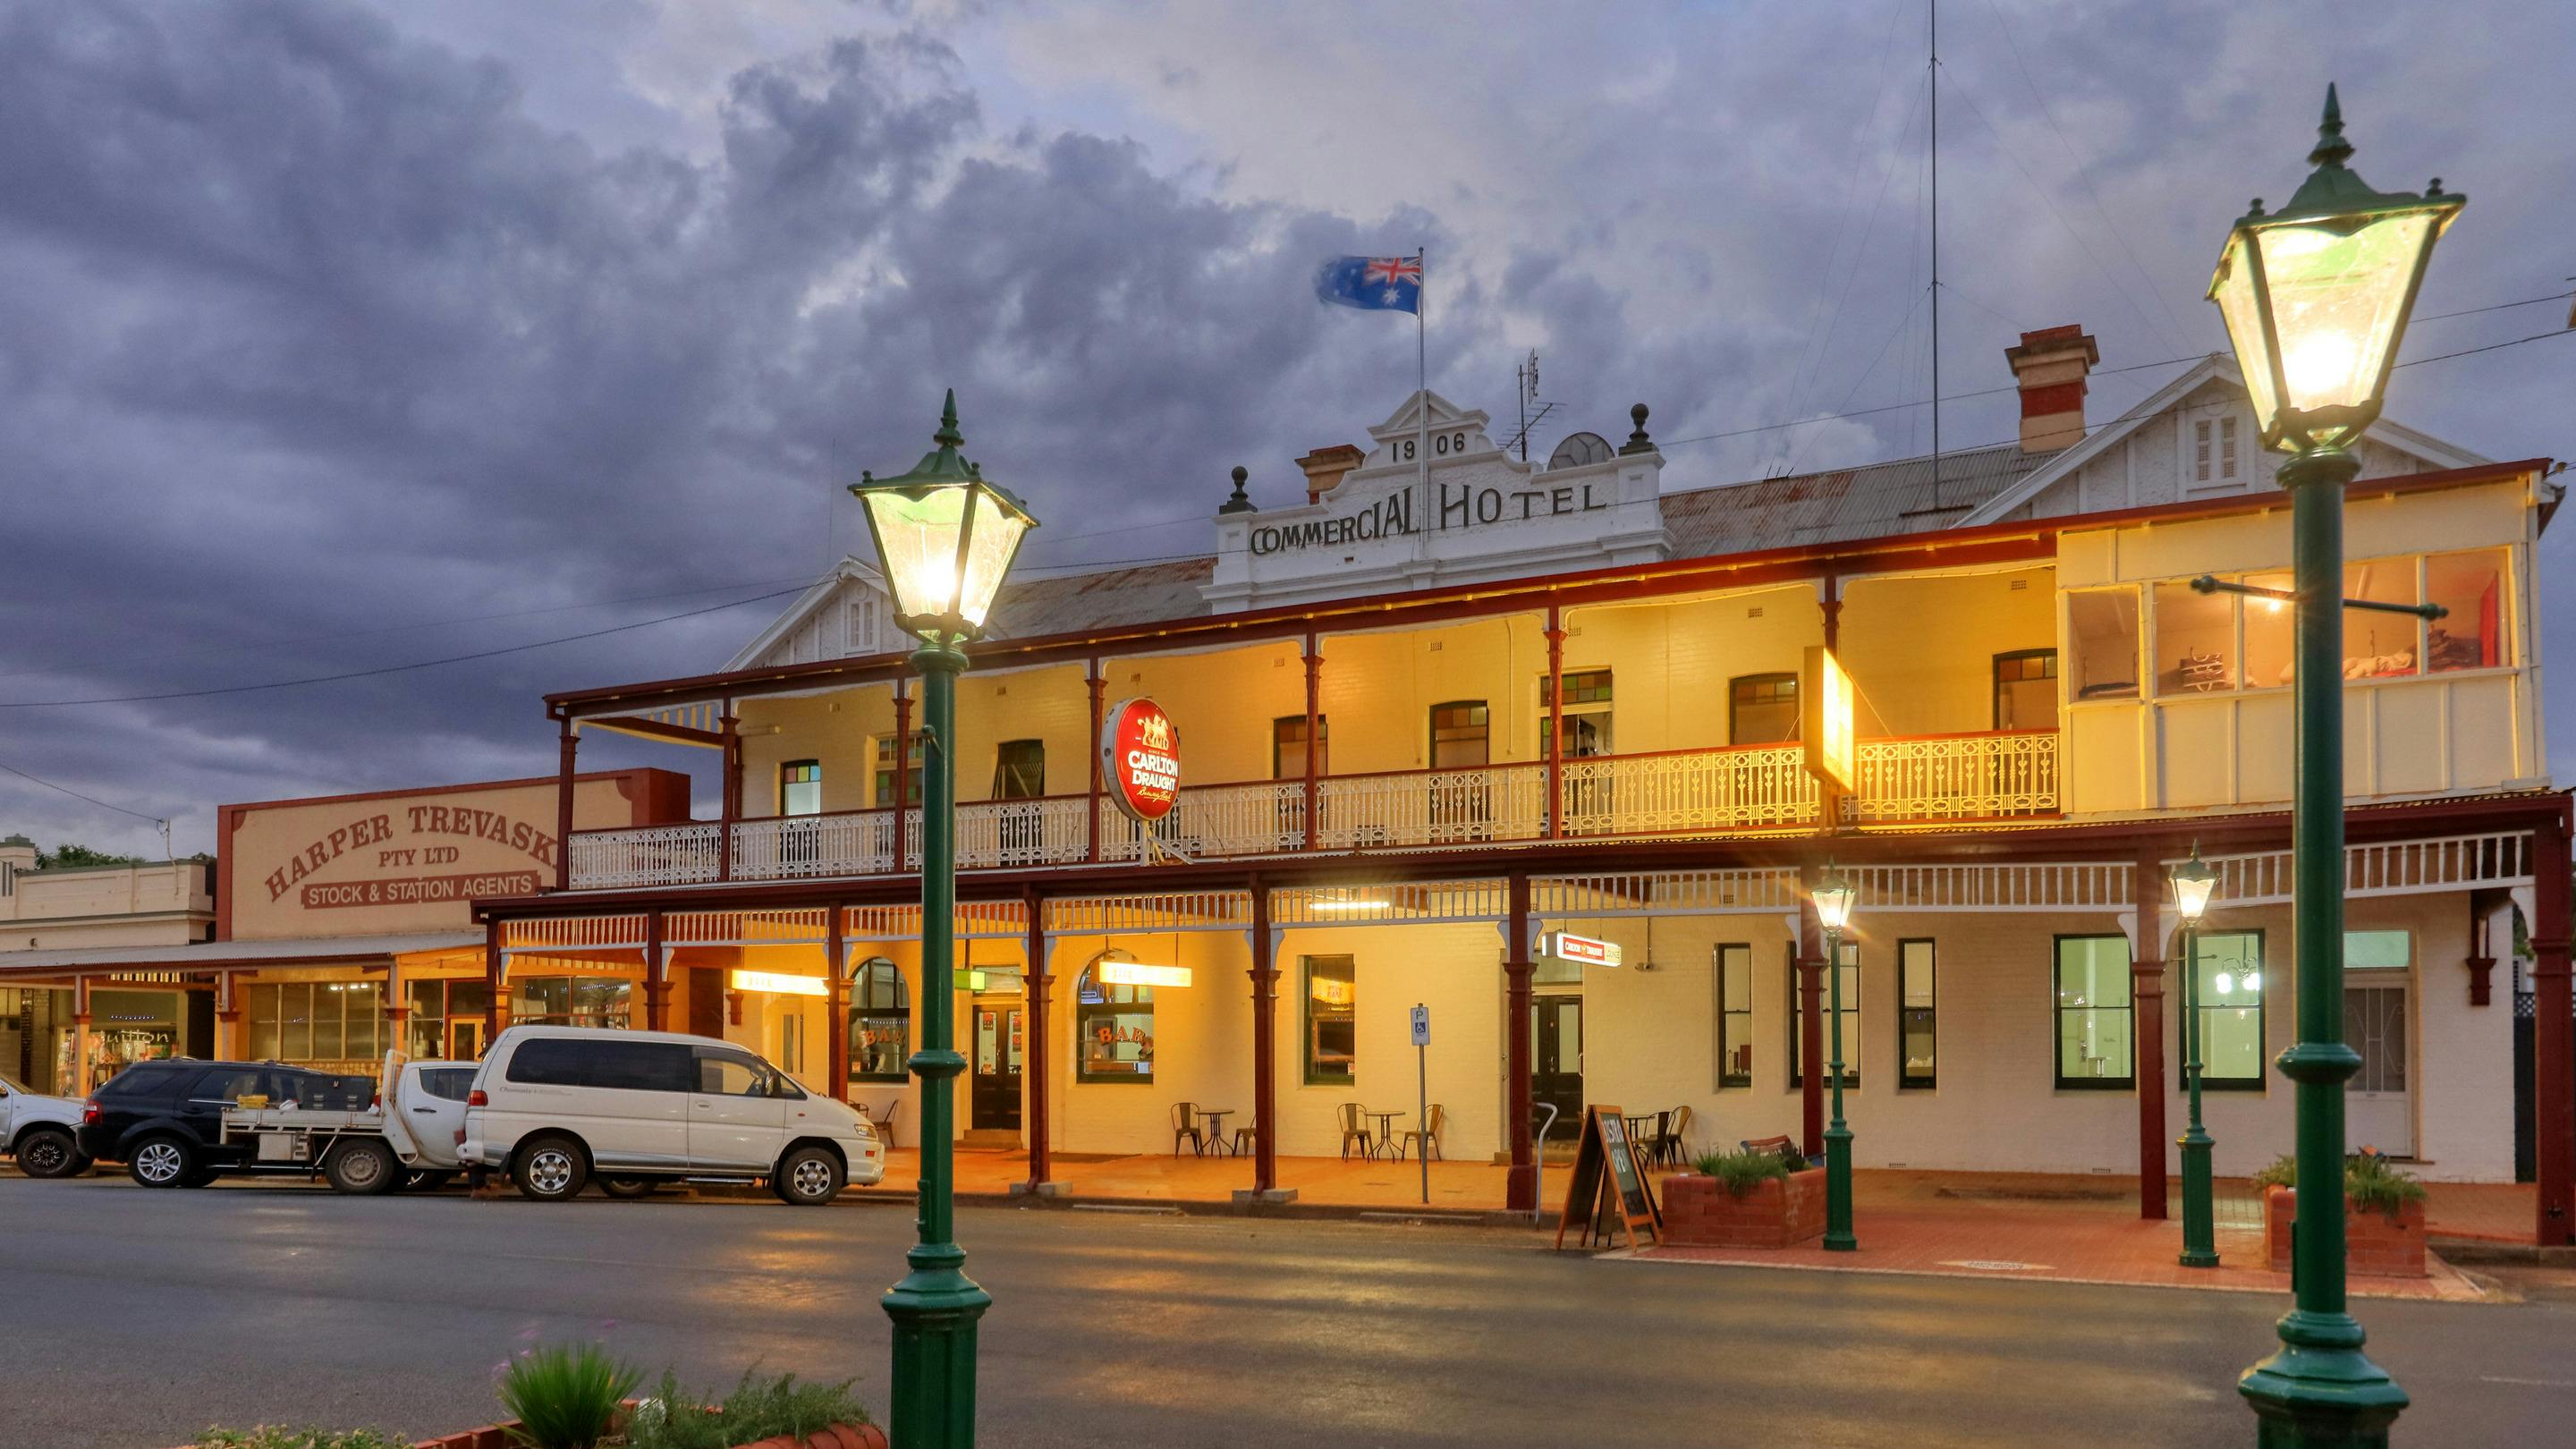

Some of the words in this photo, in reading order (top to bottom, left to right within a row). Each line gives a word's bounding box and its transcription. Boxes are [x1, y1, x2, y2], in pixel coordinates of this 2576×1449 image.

[1250, 486, 1420, 555] COMMERCIAL
[1440, 483, 1607, 531] HOTEL
[1128, 750, 1179, 777] CARLTON
[1131, 769, 1176, 792] DRAUGHT
[265, 814, 394, 902] HARPER
[408, 805, 558, 870] TREVASK
[378, 849, 416, 868] PTY
[423, 846, 460, 865] LTD
[308, 885, 363, 905] STOCK
[369, 882, 380, 901] &
[386, 877, 455, 901] STATION
[461, 874, 532, 895] AGENTS
[1415, 1010, 1424, 1020] P
[865, 1028, 906, 1047] BAR
[1097, 1025, 1146, 1046] BAR
